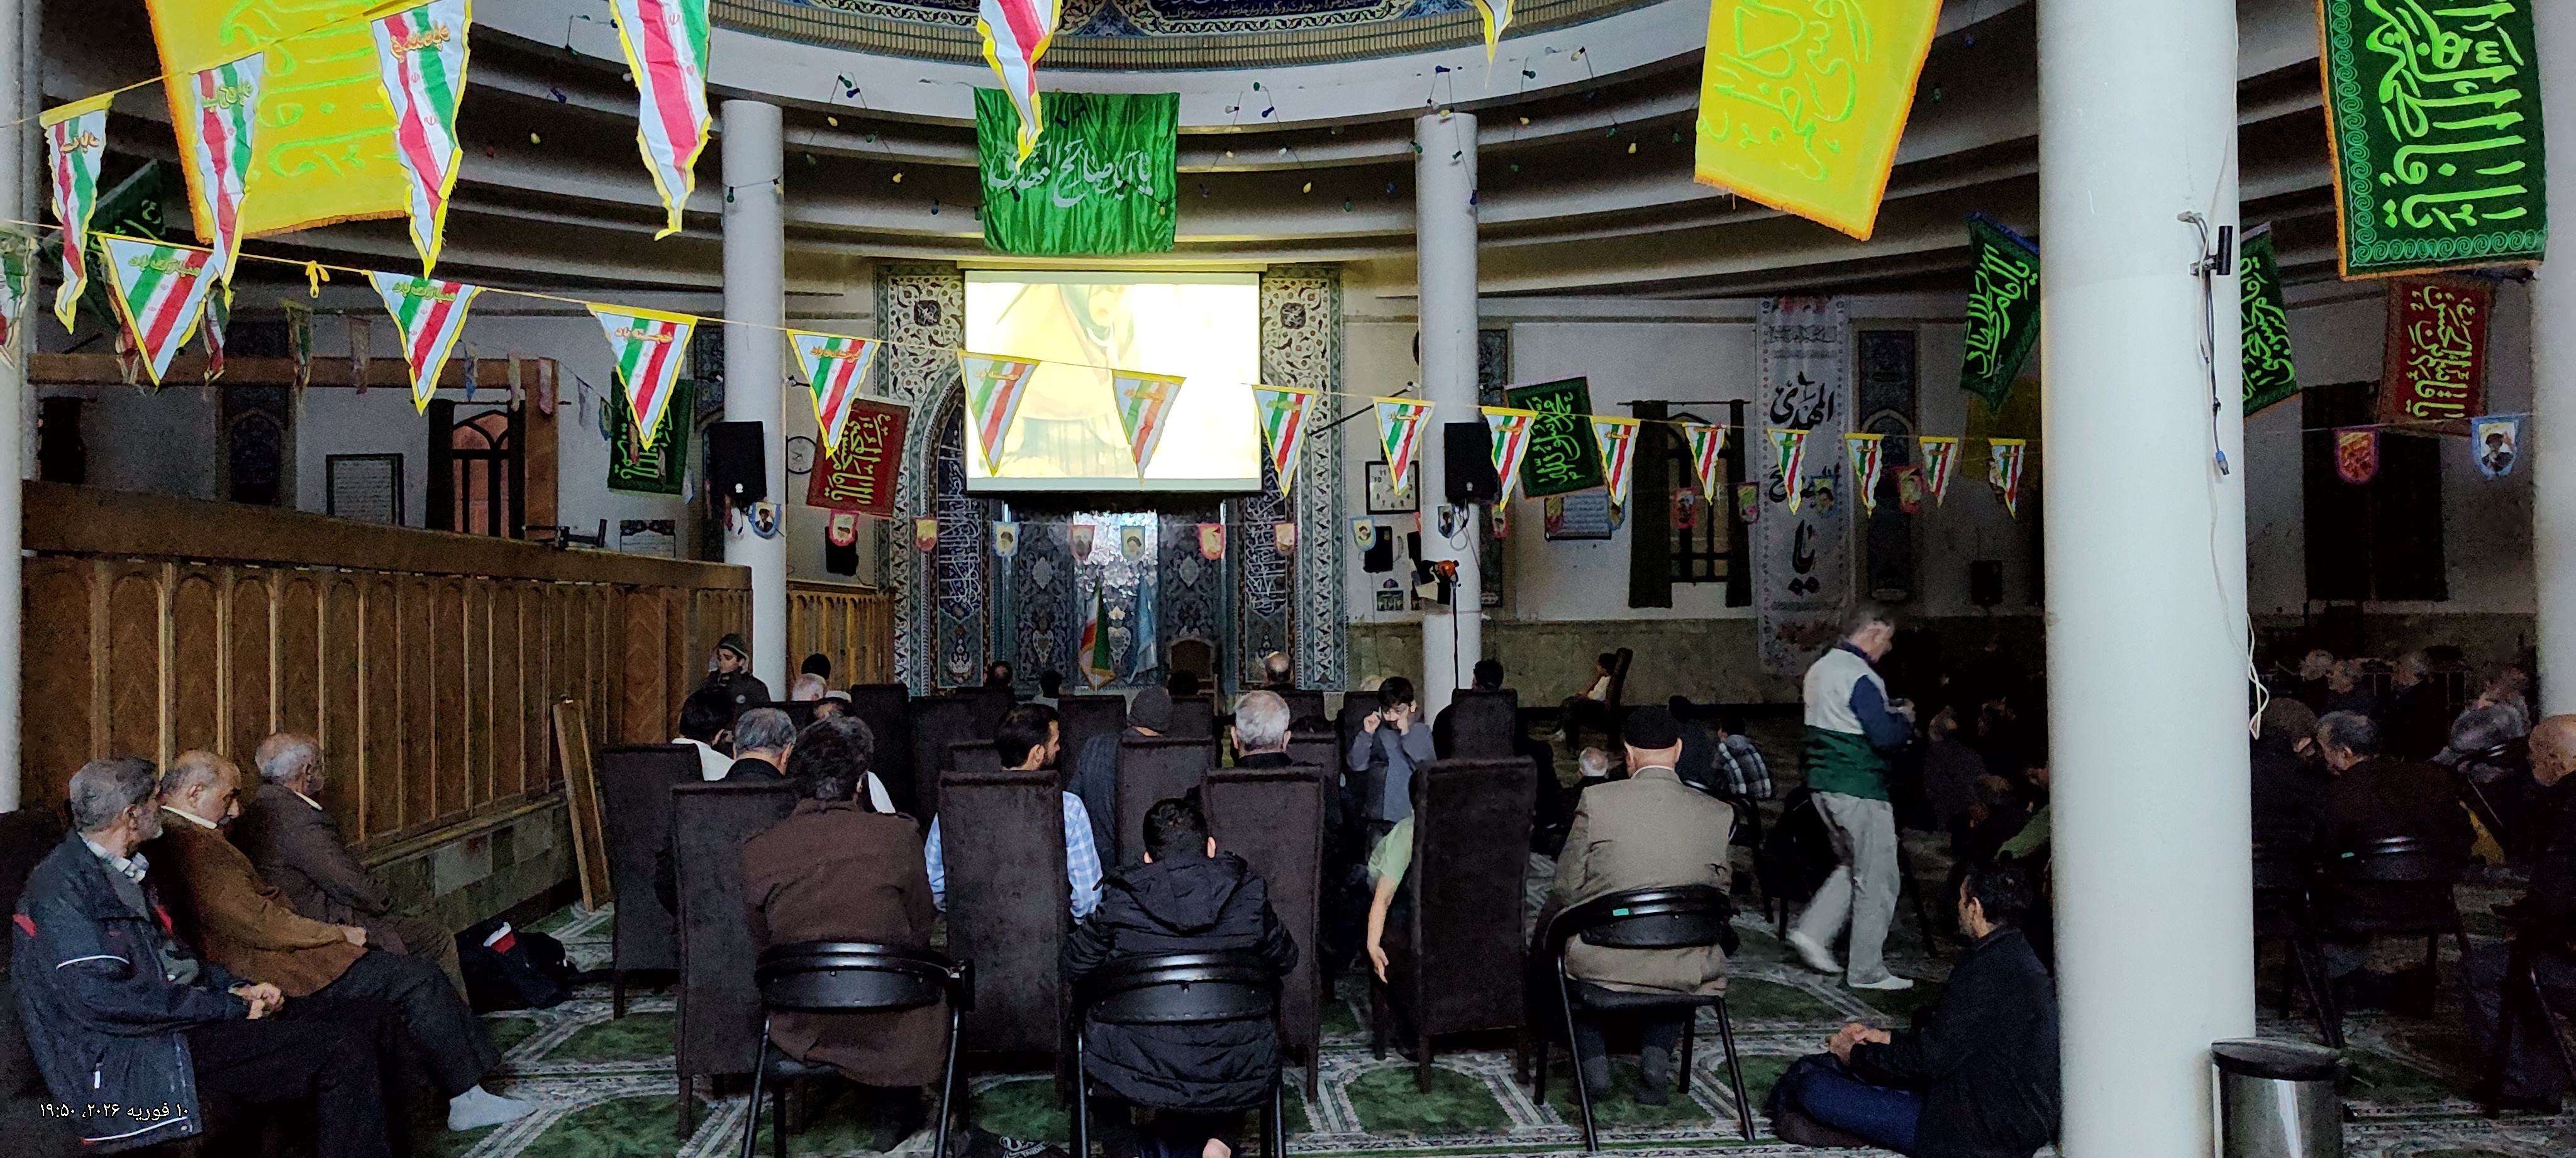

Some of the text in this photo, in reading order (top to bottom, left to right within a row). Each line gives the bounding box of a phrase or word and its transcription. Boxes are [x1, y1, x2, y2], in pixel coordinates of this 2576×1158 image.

[128, 253, 201, 278] مبارک باد
[392, 281, 457, 304] مبارک باد
[614, 326, 631, 342] باد
[809, 345, 823, 360] باد
